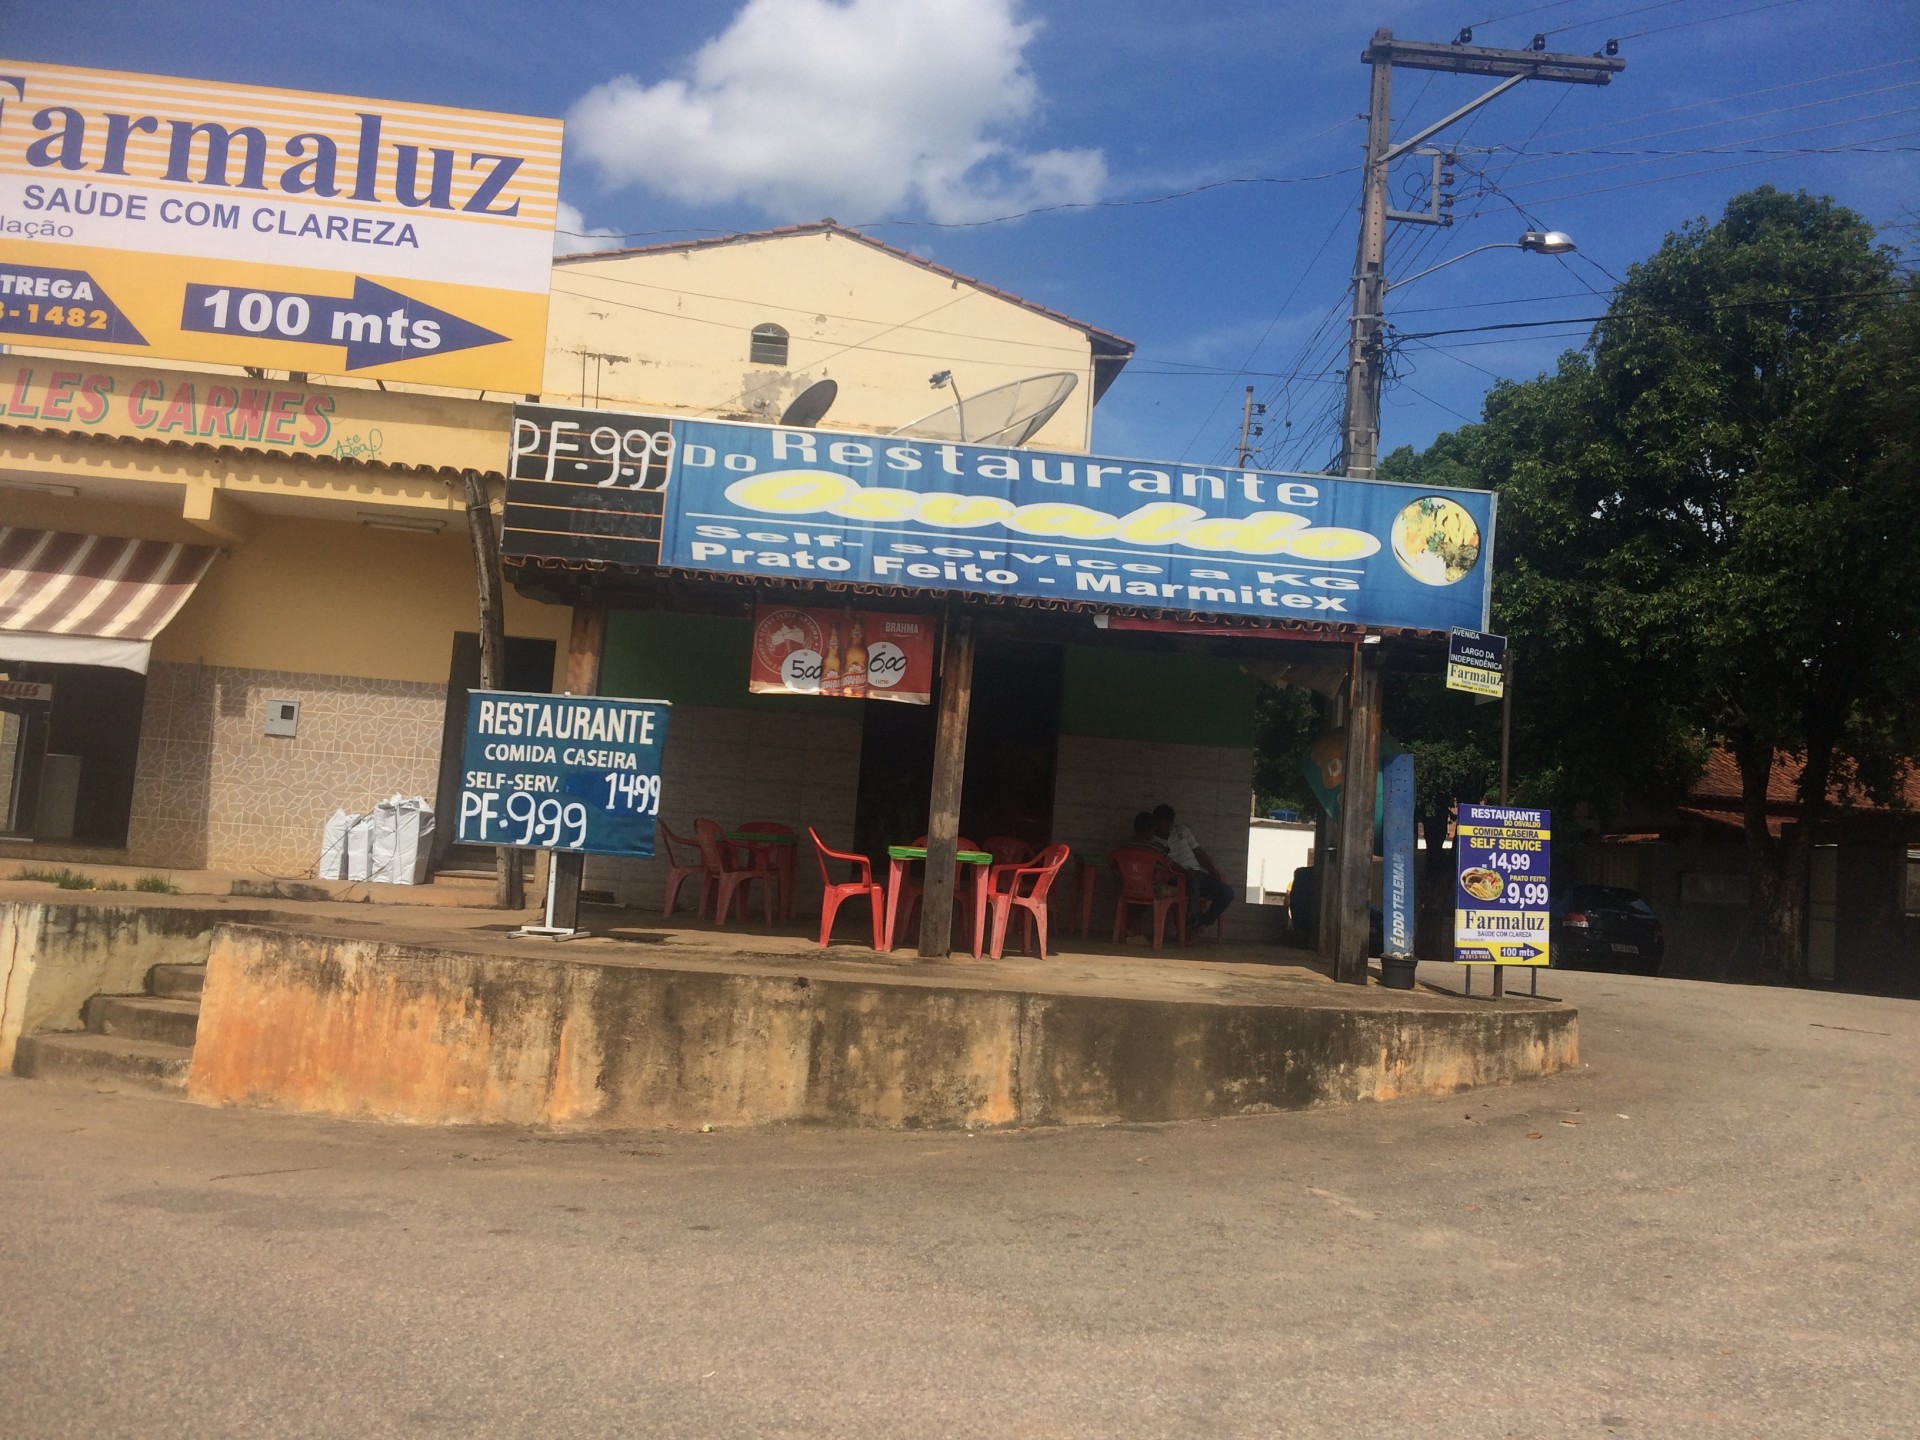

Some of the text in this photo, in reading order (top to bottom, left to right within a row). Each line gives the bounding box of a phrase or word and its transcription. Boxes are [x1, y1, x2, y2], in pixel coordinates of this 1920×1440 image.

[22, 183, 420, 250] SAÚDE COM CLAREZA
[203, 288, 442, 351] 100 mts
[0, 368, 336, 448] LES CARNES
[682, 443, 757, 472] Do
[772, 430, 1320, 508] Restaurante
[724, 469, 1382, 561] Osvaldo
[890, 543, 1163, 574] service
[1189, 567, 1230, 581] a
[691, 541, 851, 571] Prato
[873, 555, 1019, 584] Feito
[1075, 571, 1349, 612] Marmitex
[885, 622, 919, 634] BRAHMA
[1452, 628, 1480, 640] AVENIDA
[869, 652, 908, 673] 6,00
[1461, 645, 1495, 660] LARGO DA
[1450, 664, 1503, 687] Farmaluz
[478, 701, 656, 745] RESTAURANTE
[485, 743, 637, 770] COMIDA CASEIRA
[465, 771, 560, 793] SELF-SERV.
[1471, 808, 1541, 821] RESTAURANTE
[1513, 820, 1541, 828] OSVALDO
[1472, 827, 1539, 839] COMIDA CASEIRA
[1470, 838, 1541, 851] SELF SERVICE
[1488, 852, 1530, 873] 14,99
[1509, 874, 1528, 882] PRATO
[1507, 882, 1548, 909] 9,99
[1464, 911, 1544, 930] Farmaluz
[1502, 947, 1535, 957] 100 mts
